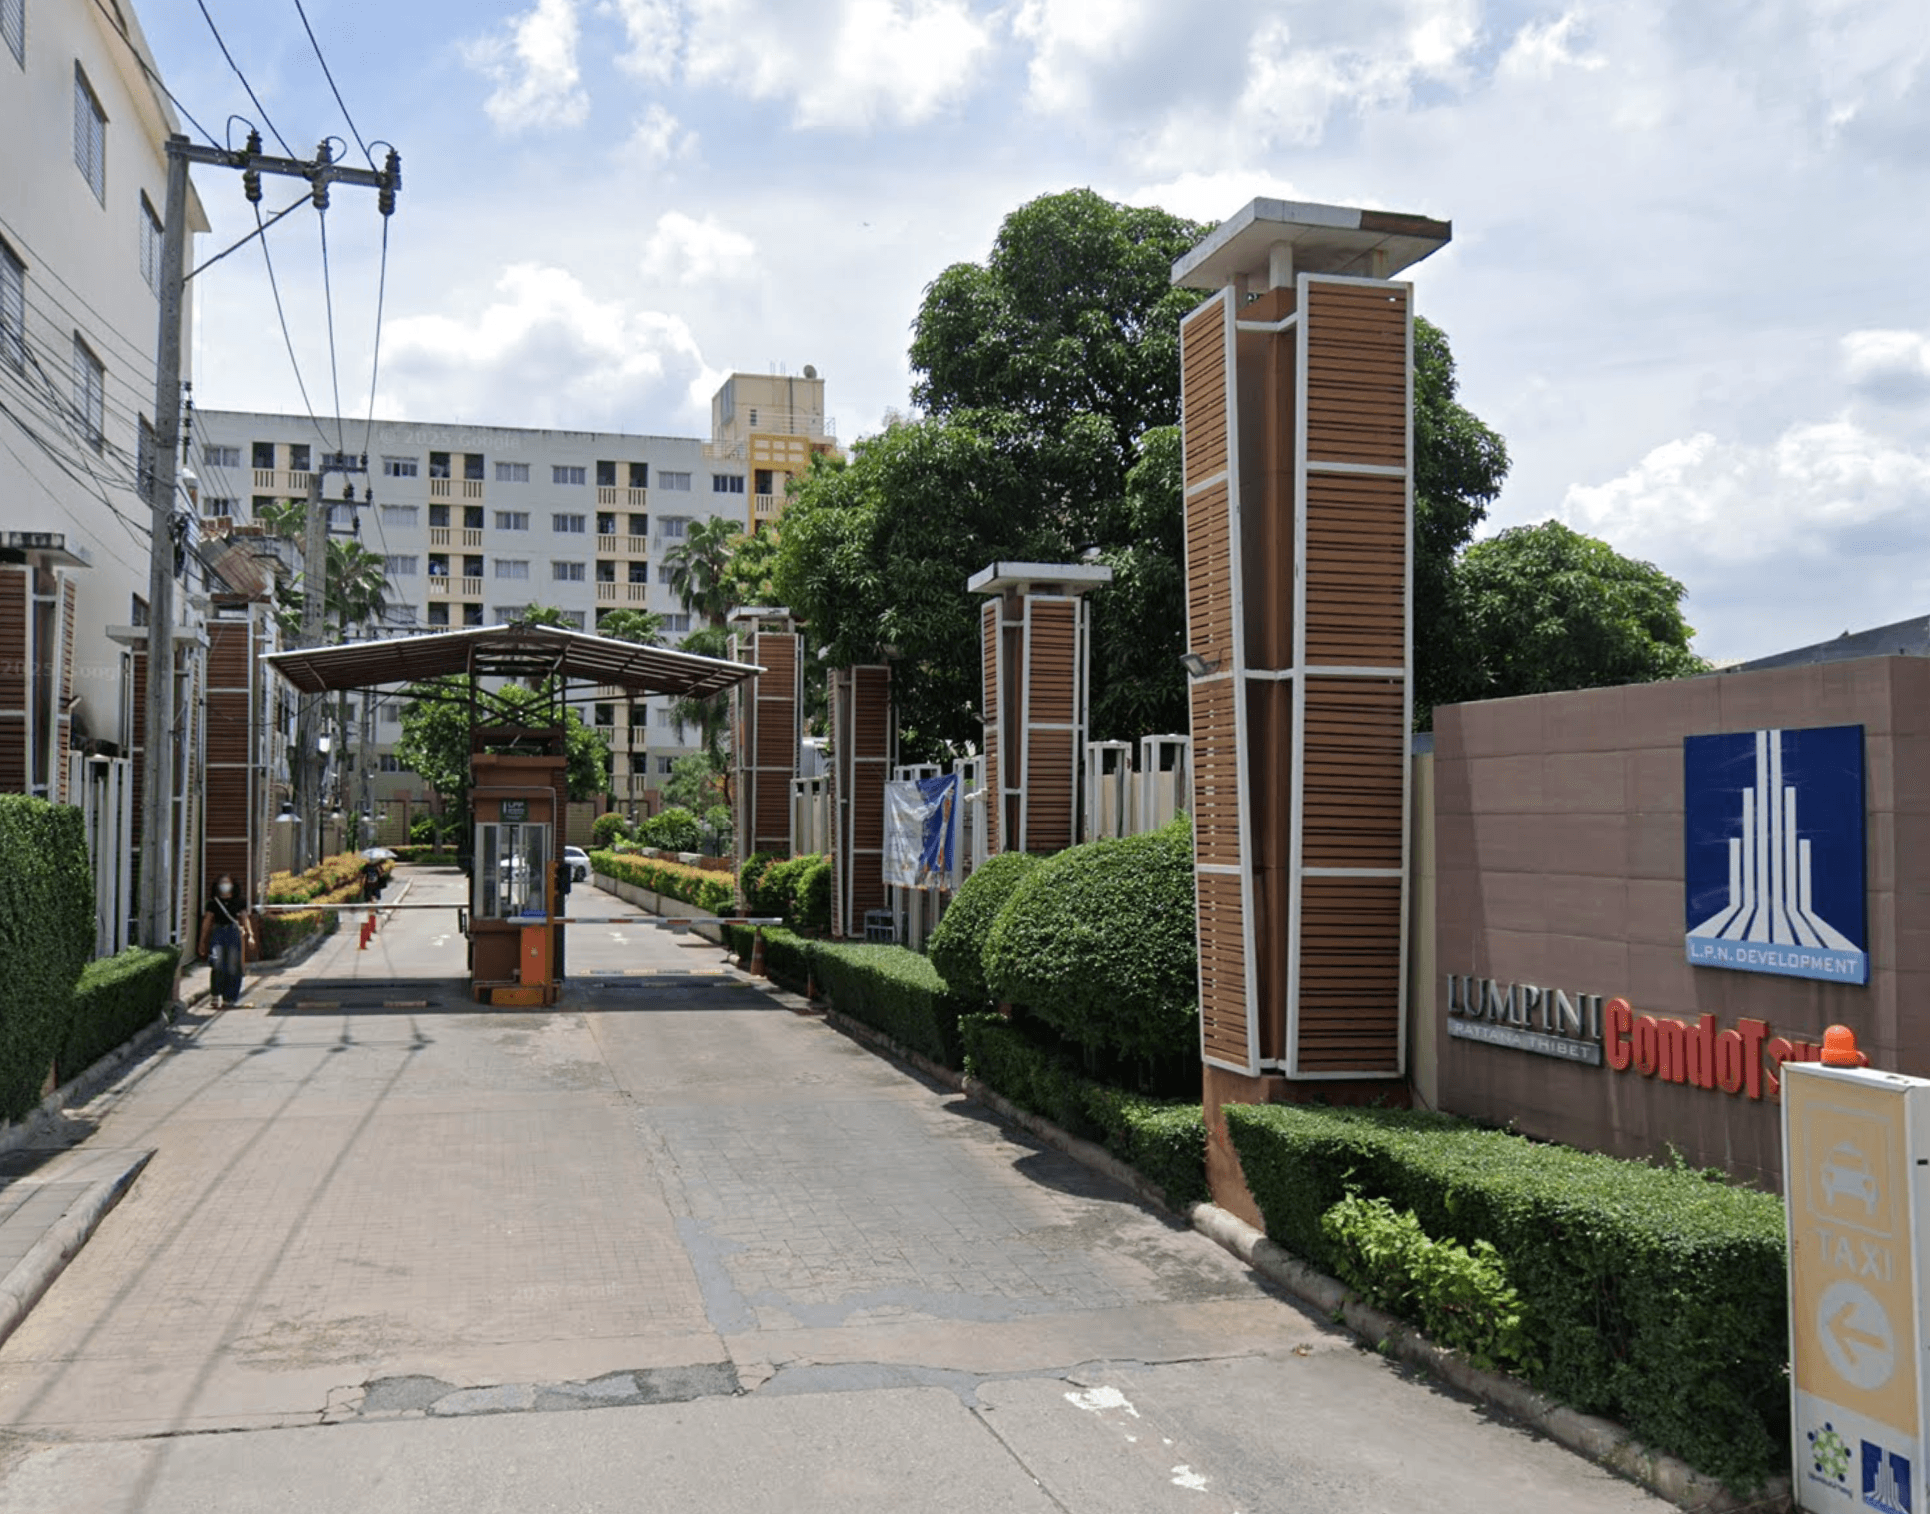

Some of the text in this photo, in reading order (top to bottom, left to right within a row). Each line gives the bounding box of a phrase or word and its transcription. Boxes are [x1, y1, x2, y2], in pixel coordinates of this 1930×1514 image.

[1690, 943, 1859, 975] L.P.N. DEVELOPMENT
[1447, 974, 1603, 1039] LUMPINI
[1454, 1023, 1592, 1059] RATTANA THIBET
[1814, 1225, 1894, 1282] TAXI
